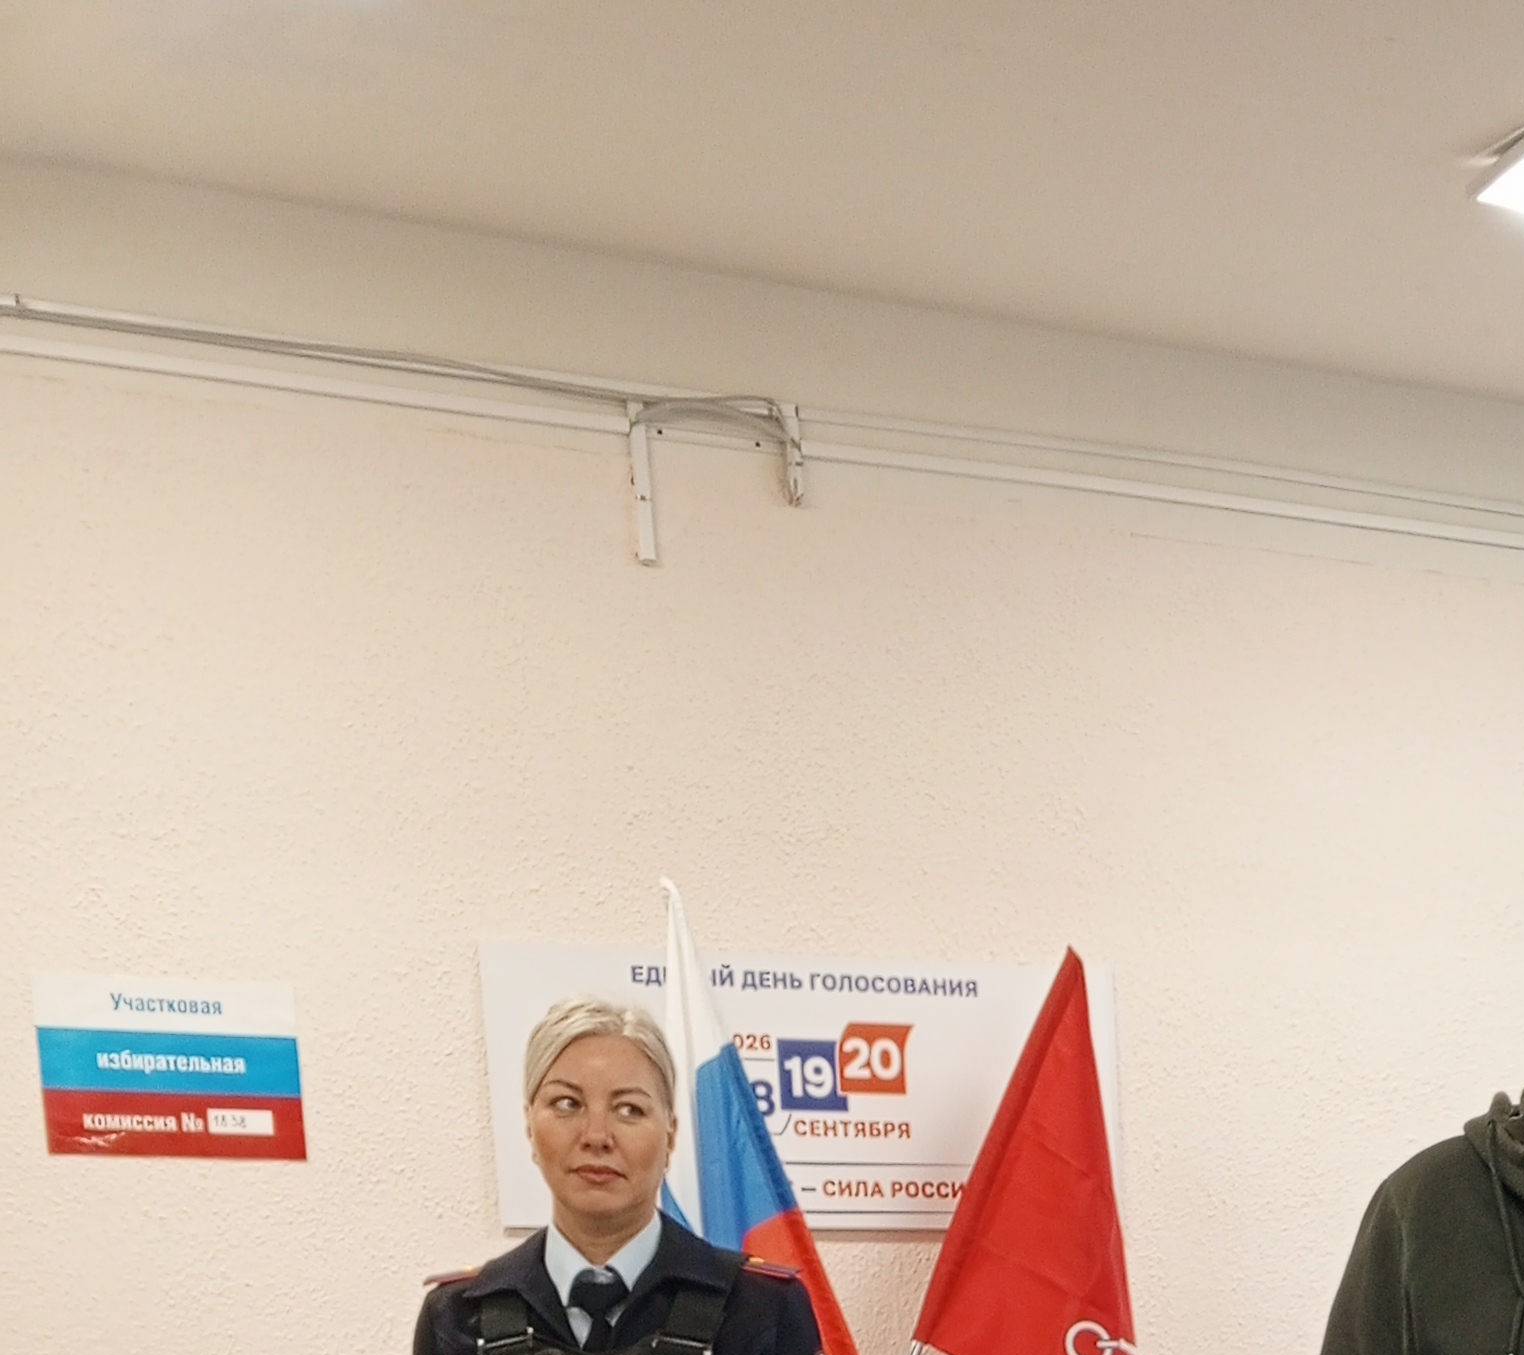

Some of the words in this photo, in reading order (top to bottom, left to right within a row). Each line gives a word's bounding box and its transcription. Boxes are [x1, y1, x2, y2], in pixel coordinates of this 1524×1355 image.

[742, 970, 801, 991] ДЕНЬ
[810, 973, 978, 998] ГОЛОСОВАНИЯ
[110, 992, 222, 1015] Участковая
[732, 1034, 771, 1051] 026
[96, 1049, 246, 1075] избирательная
[784, 1056, 834, 1099] 19
[843, 1038, 902, 1081] 20
[82, 1112, 178, 1132] комиссия
[181, 1111, 205, 1133] №
[213, 1114, 247, 1129] 1838
[794, 1119, 911, 1139] СЕНТЯБРЯ
[823, 1180, 884, 1199] СИЛА
[892, 1182, 966, 1200] РОССИ
